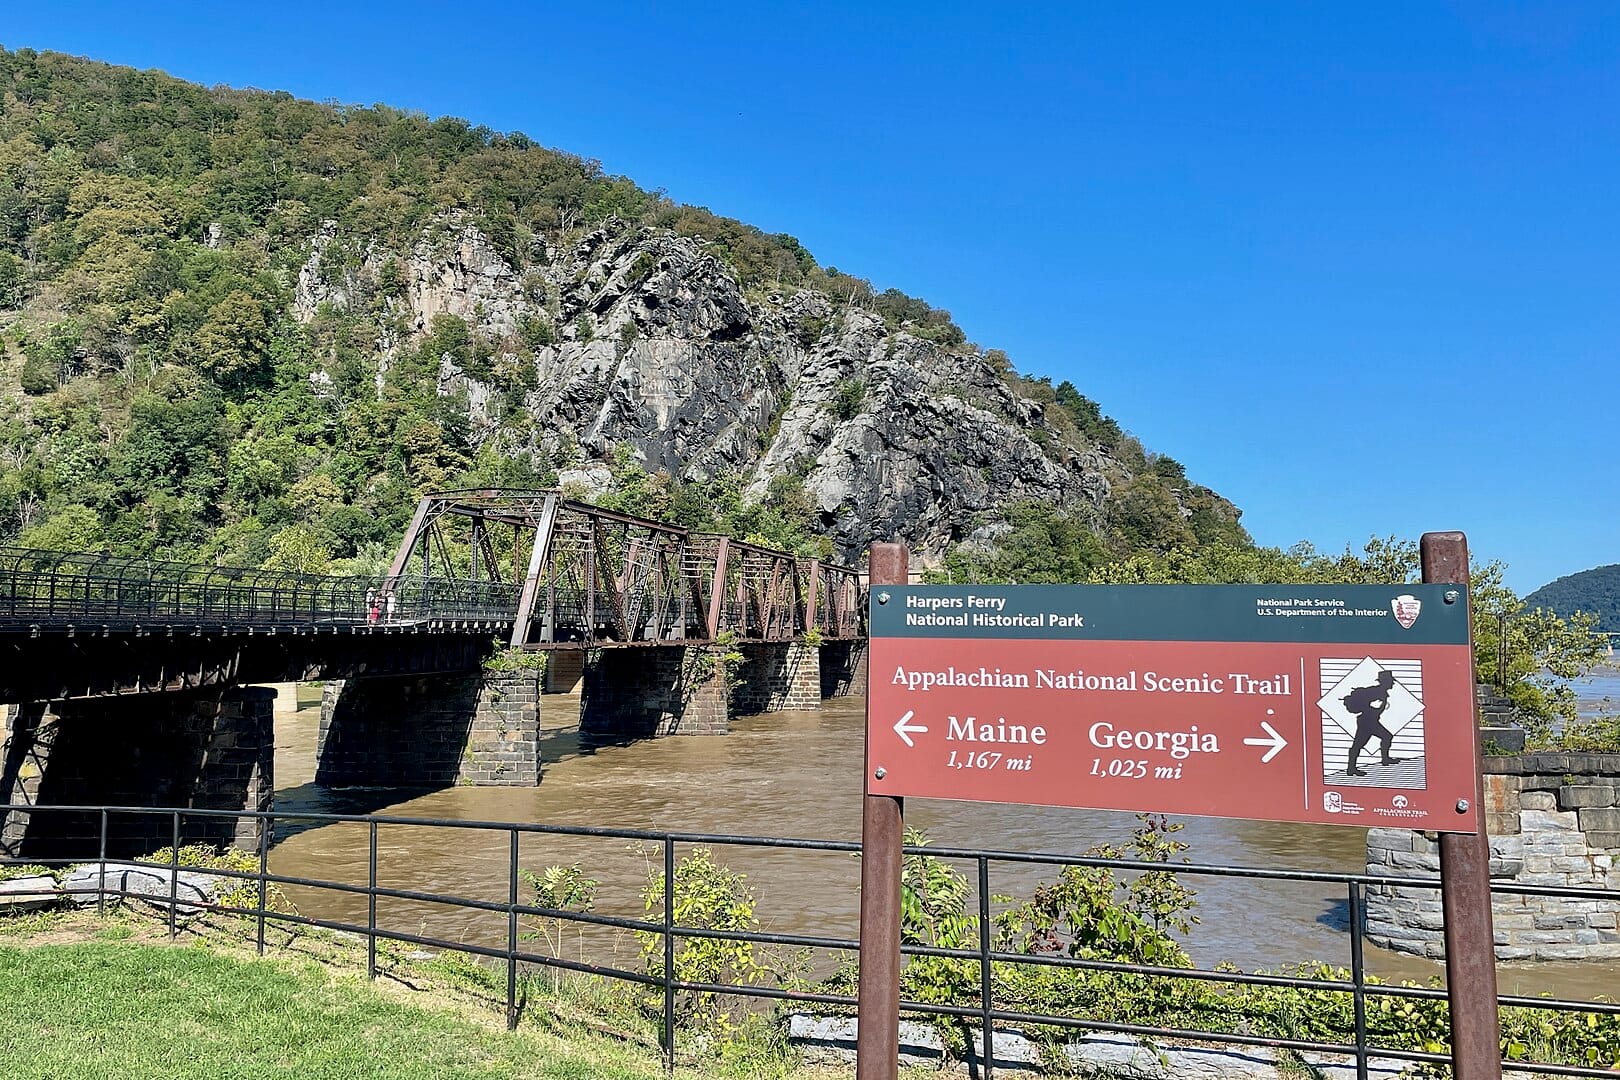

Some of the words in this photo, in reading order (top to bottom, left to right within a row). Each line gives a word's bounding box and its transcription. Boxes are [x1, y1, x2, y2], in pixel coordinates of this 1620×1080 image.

[906, 595, 964, 611] Harpers
[967, 595, 1006, 612] Ferry
[1257, 598, 1292, 607] National
[1293, 598, 1312, 607] Park
[1314, 598, 1344, 607] Service
[906, 612, 968, 626] National
[973, 613, 1044, 627] Historical
[1049, 613, 1084, 627] Park
[1257, 608, 1273, 616] U.S.
[1275, 608, 1325, 618] Department
[1327, 608, 1336, 616] of
[1338, 608, 1353, 616] the
[1354, 608, 1387, 617] Interior
[891, 665, 1030, 692] Appalachian
[1034, 669, 1138, 691] National
[1143, 671, 1224, 694] Scenic
[1228, 673, 1292, 695] Trail
[945, 715, 1047, 745] Maine
[1088, 722, 1221, 758] Georgia
[947, 750, 1003, 770] 1,167
[1006, 754, 1033, 771] mi
[1089, 758, 1149, 779] 1,025
[1154, 762, 1183, 780] mi
